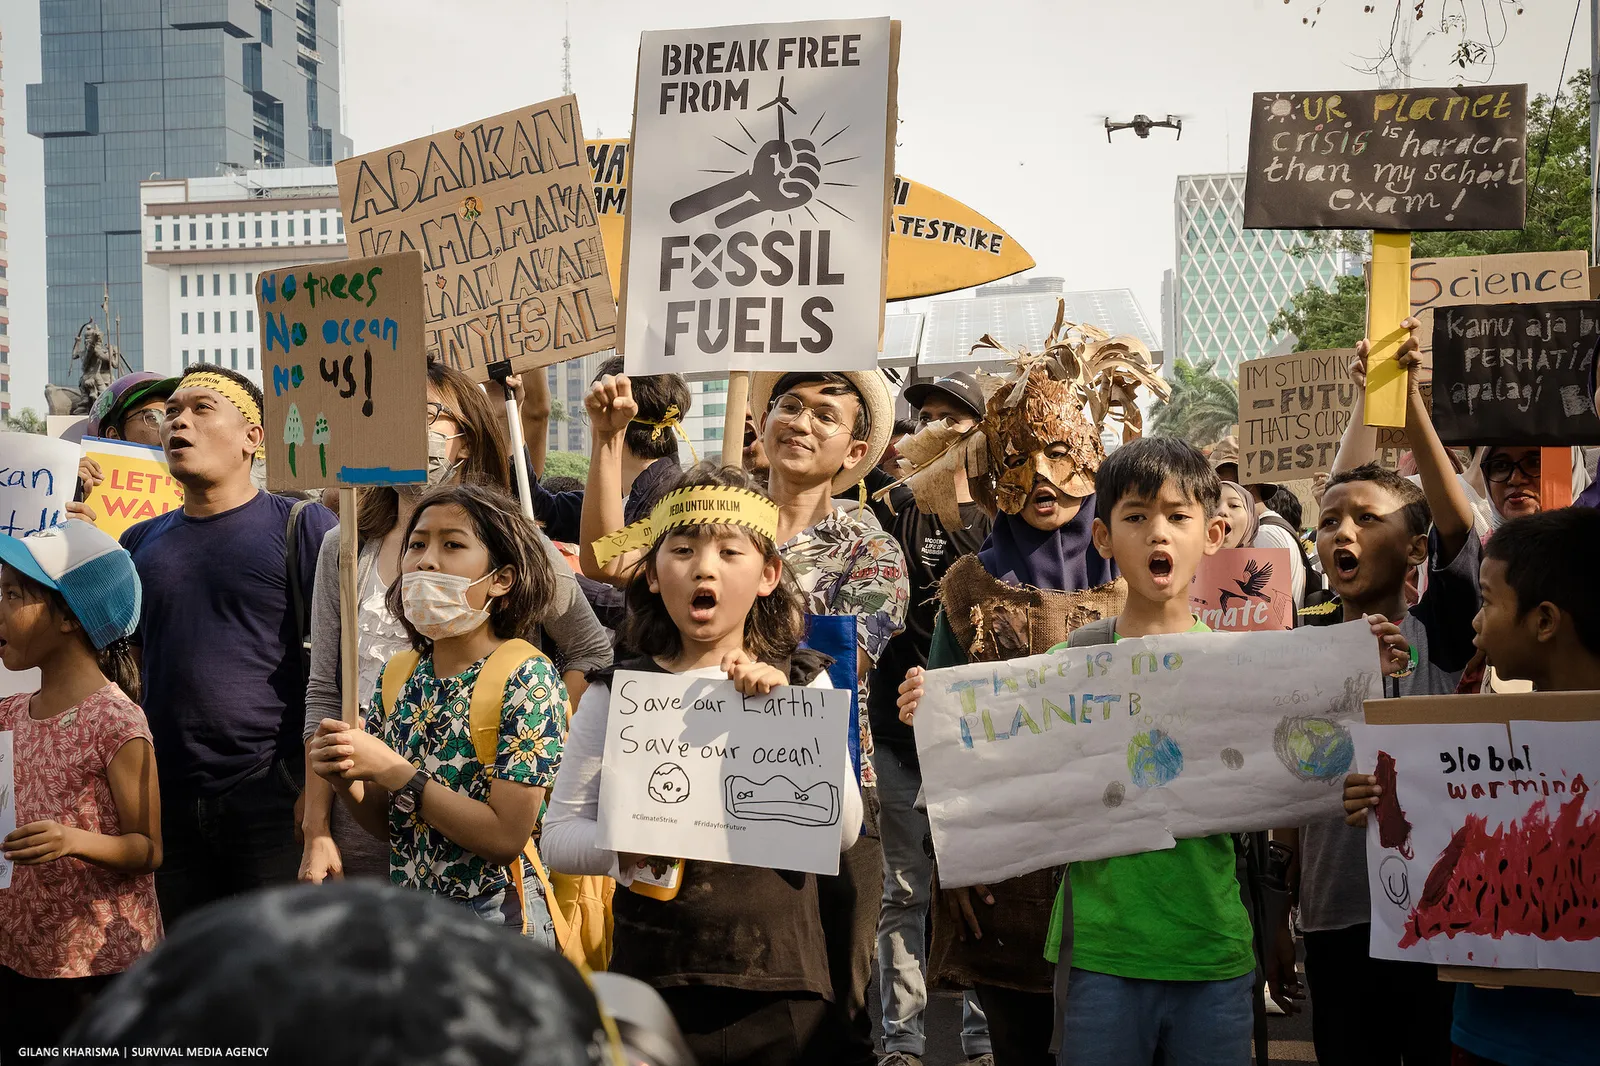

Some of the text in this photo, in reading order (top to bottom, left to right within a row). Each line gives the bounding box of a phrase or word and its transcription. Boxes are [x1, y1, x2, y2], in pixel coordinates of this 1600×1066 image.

[661, 34, 861, 76] BREAK FREE
[659, 79, 749, 115] FROM
[1272, 120, 1518, 158] crisis is harder
[1263, 156, 1352, 184] than
[1373, 163, 1417, 194] my
[495, 183, 598, 252] MAKA
[509, 236, 604, 300] AKAN
[1411, 262, 1583, 306] Science
[322, 316, 398, 351] ocean
[664, 295, 835, 356] FUELS
[1526, 313, 1567, 342] aja
[1246, 364, 1268, 391] I'M
[685, 499, 715, 512] UNTUK
[716, 499, 741, 512] IKLIM
[619, 680, 825, 719] Save our Earth!
[945, 660, 1071, 713] There
[1131, 651, 1183, 675] no
[960, 693, 1122, 750] PLANET
[1128, 692, 1142, 716] B
[619, 725, 822, 768] Save our ocean!
[1440, 744, 1533, 774] global
[1447, 772, 1590, 801] warming
[632, 813, 678, 825] #ClimateStrike
